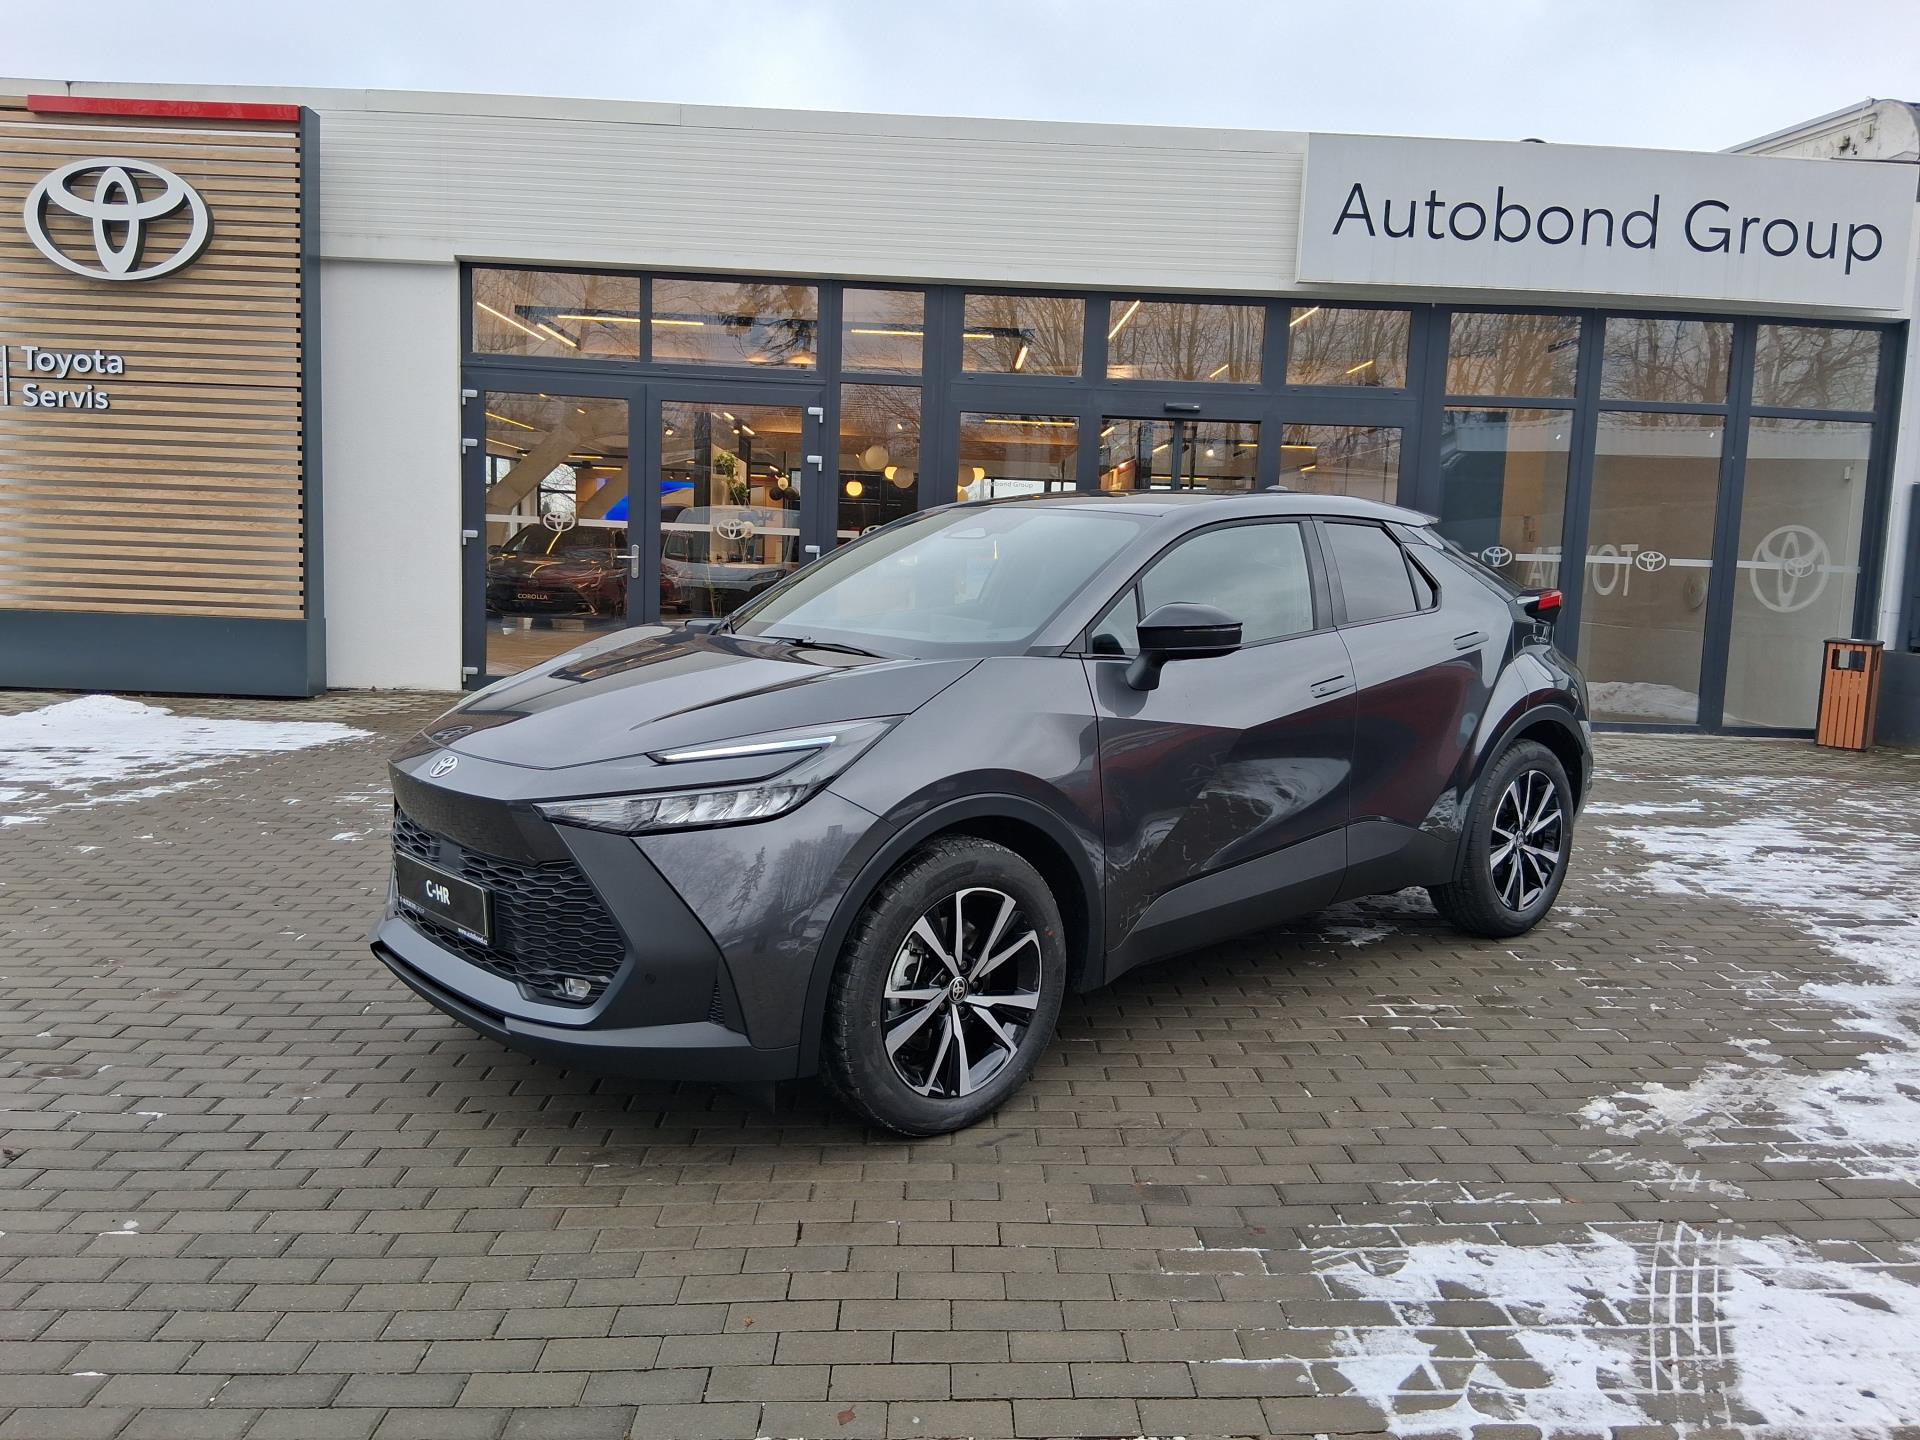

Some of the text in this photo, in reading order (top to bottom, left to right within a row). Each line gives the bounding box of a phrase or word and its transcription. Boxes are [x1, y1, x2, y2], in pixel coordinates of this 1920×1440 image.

[1332, 183, 1883, 275] Autobond Group
[20, 345, 124, 379] Toyota
[22, 383, 110, 410] Servis
[426, 879, 451, 905] C-HR
